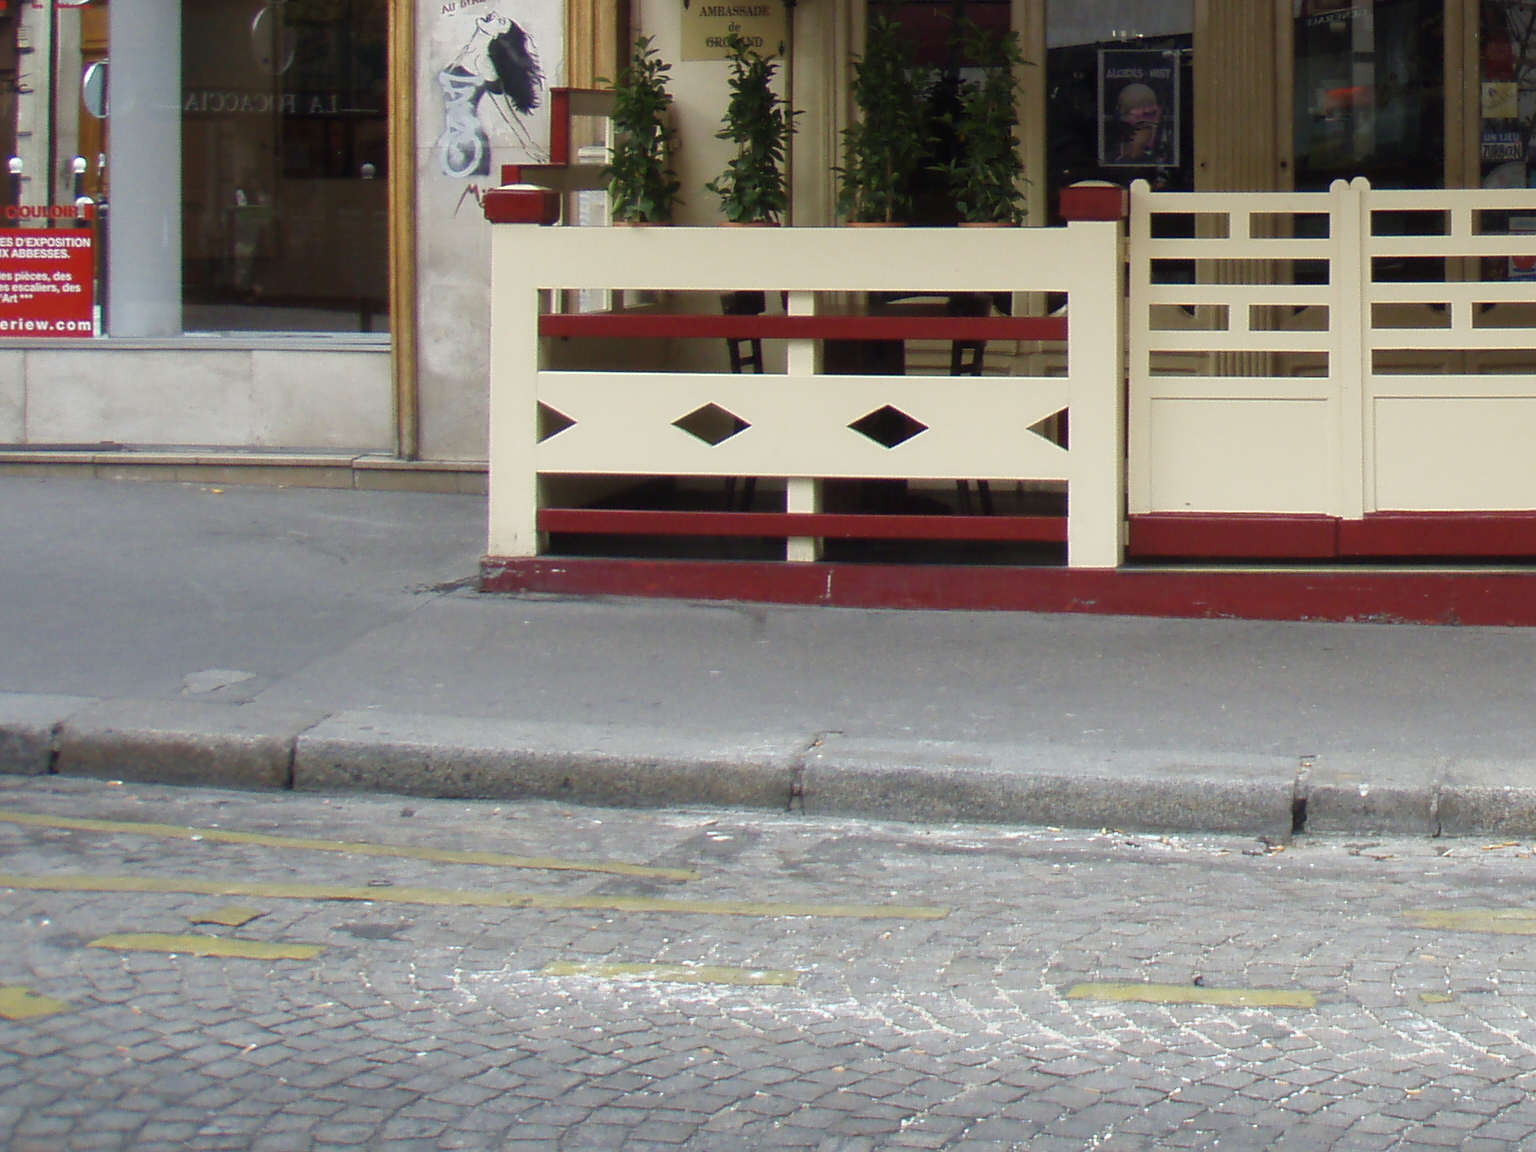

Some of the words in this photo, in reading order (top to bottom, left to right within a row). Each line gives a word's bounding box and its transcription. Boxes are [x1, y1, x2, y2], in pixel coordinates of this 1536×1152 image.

[699, 5, 771, 17] AMBASSADE
[728, 21, 742, 32] de
[16, 237, 91, 247] D'EXPOSITION
[12, 249, 71, 259] ABBESSES.
[14, 271, 51, 282] pièces,
[53, 270, 72, 281] des
[12, 282, 60, 294] escaliers,
[62, 282, 81, 293] des
